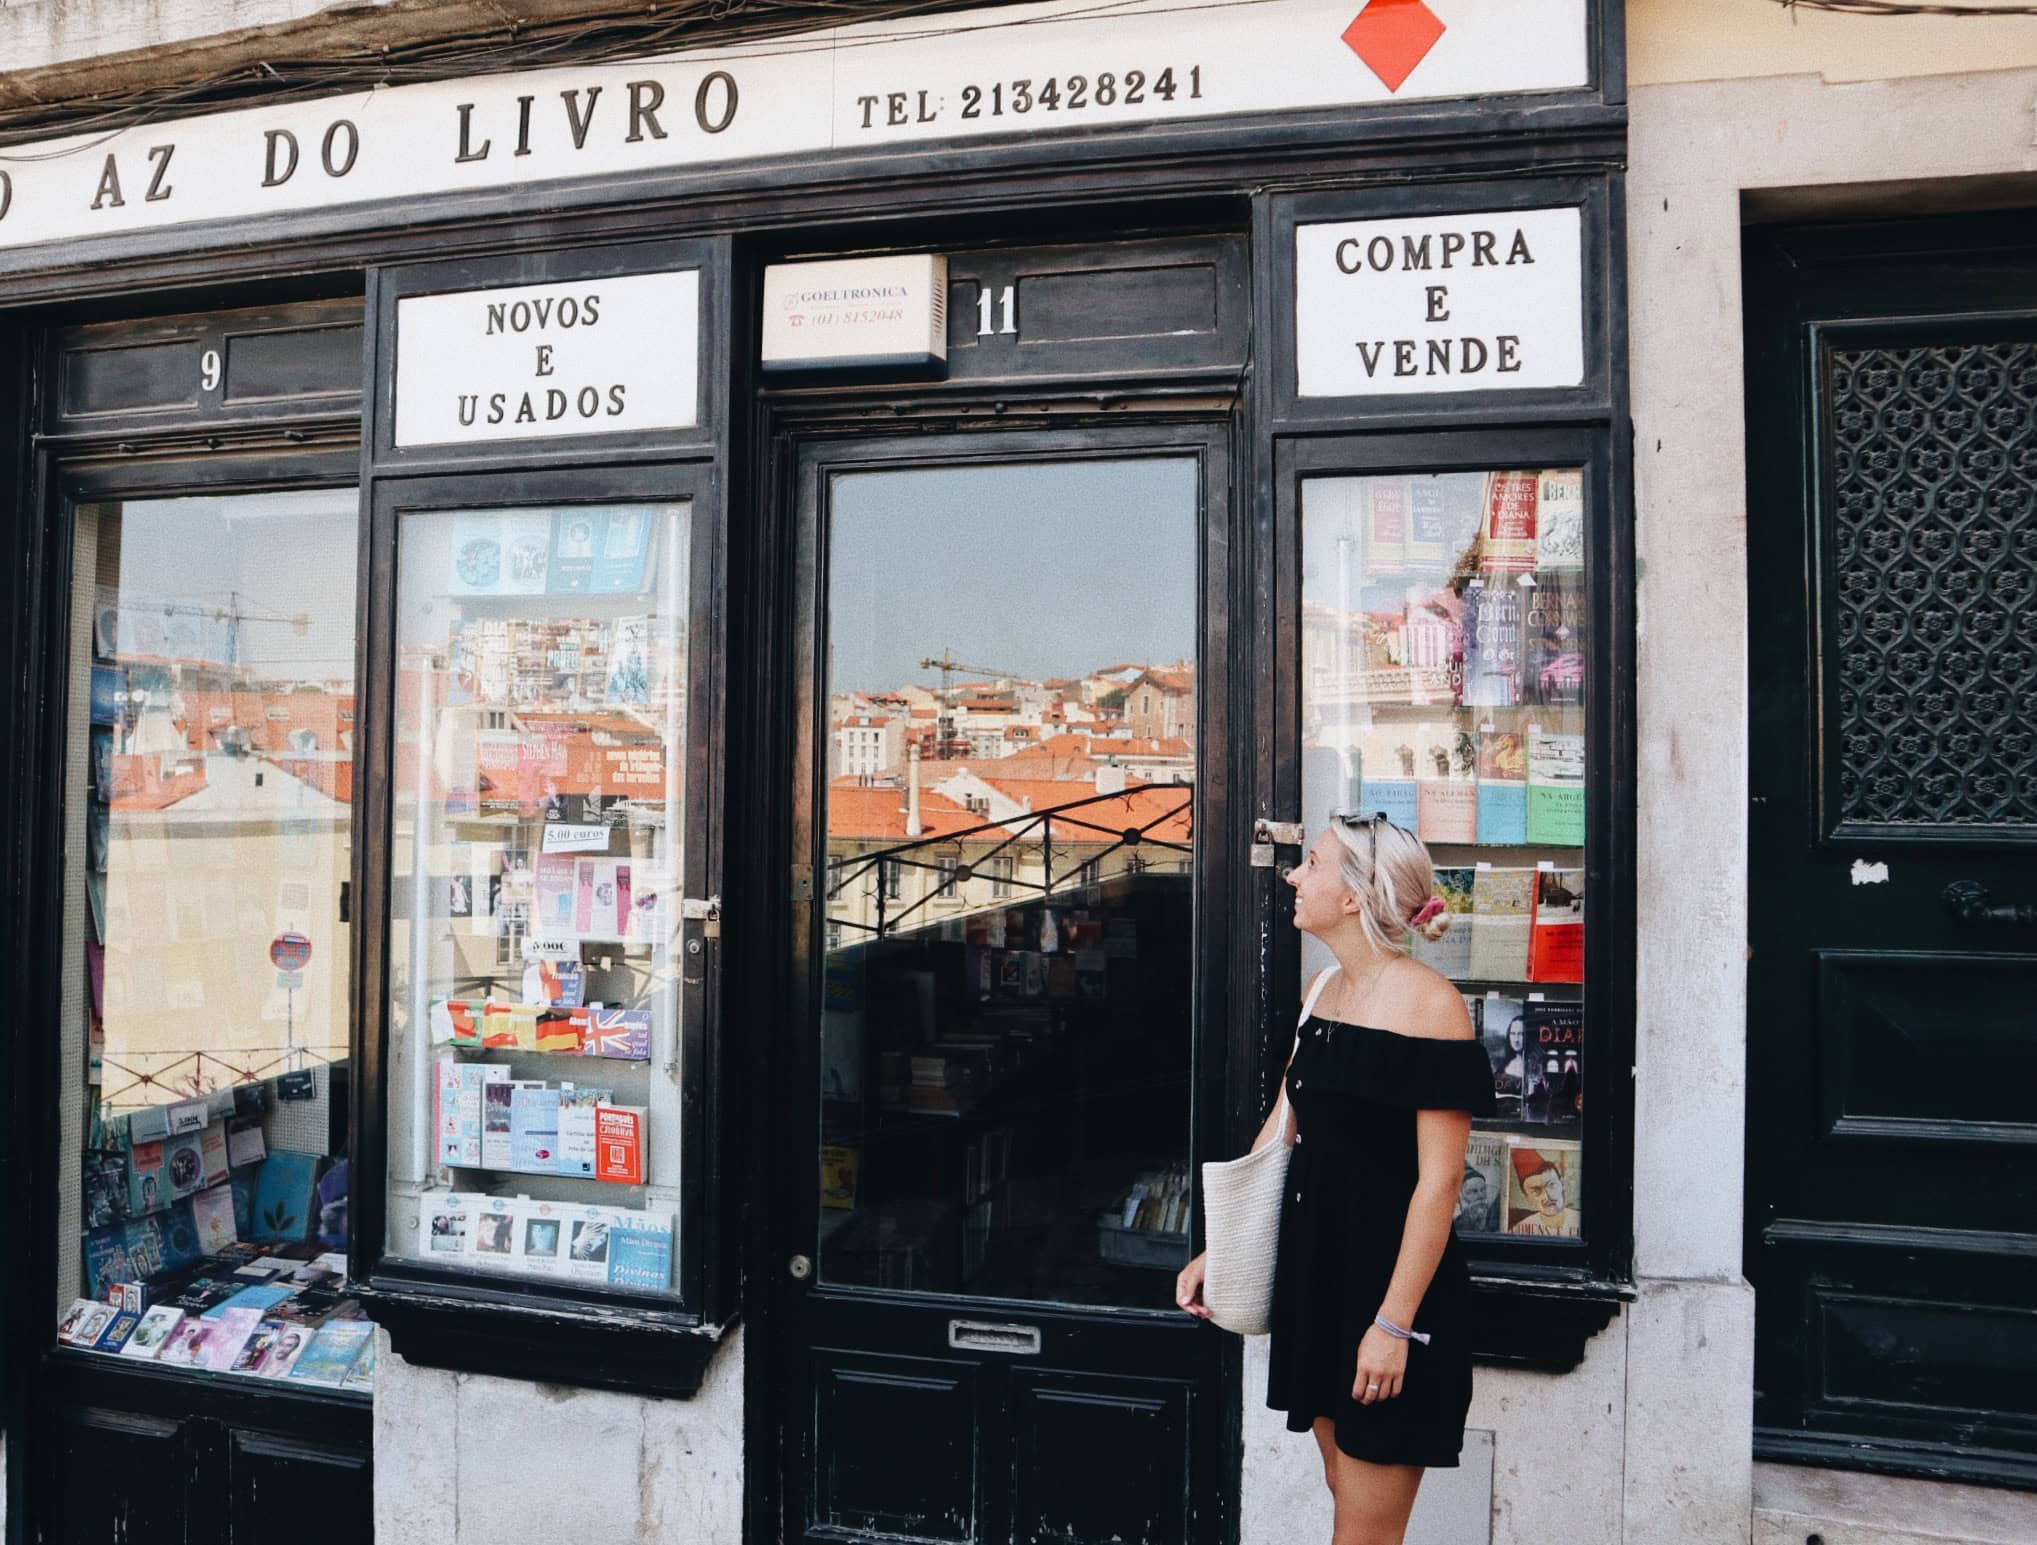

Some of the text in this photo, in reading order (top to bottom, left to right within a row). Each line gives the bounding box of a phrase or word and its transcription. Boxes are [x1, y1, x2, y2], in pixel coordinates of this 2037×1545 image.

[961, 64, 1204, 120] 213428241
[91, 144, 175, 209] AZ
[261, 119, 359, 188] DO
[454, 70, 739, 163] LIVRO
[1335, 228, 1535, 275] COMPRA
[801, 286, 908, 302] GOELTRONICA
[976, 286, 1017, 336] 11
[1425, 285, 1450, 322] E
[486, 295, 600, 335] NOVOS
[201, 350, 221, 391] 9
[535, 345, 554, 377] E
[1355, 335, 1522, 378] VENDE
[460, 384, 625, 426] USADOS
[574, 830, 605, 841] euros
